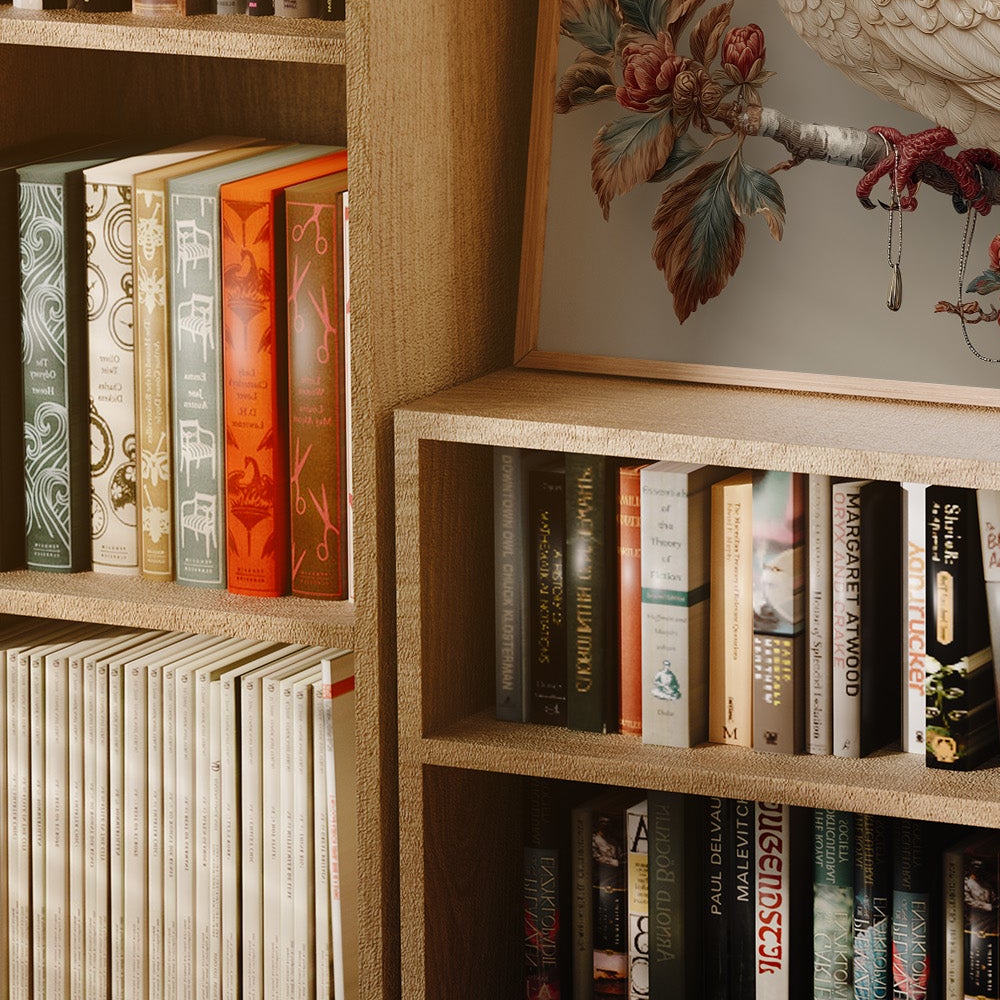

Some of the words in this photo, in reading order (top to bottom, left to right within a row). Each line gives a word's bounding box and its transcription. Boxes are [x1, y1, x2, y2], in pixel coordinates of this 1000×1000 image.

[501, 453, 514, 528] DOWNTOWN
[833, 491, 845, 544] ORYX
[501, 530, 514, 557] OWL
[846, 492, 859, 606] MARGARET
[833, 600, 845, 670] CRAKE
[846, 611, 860, 698] ATWOOD
[710, 871, 723, 915] PAUL
